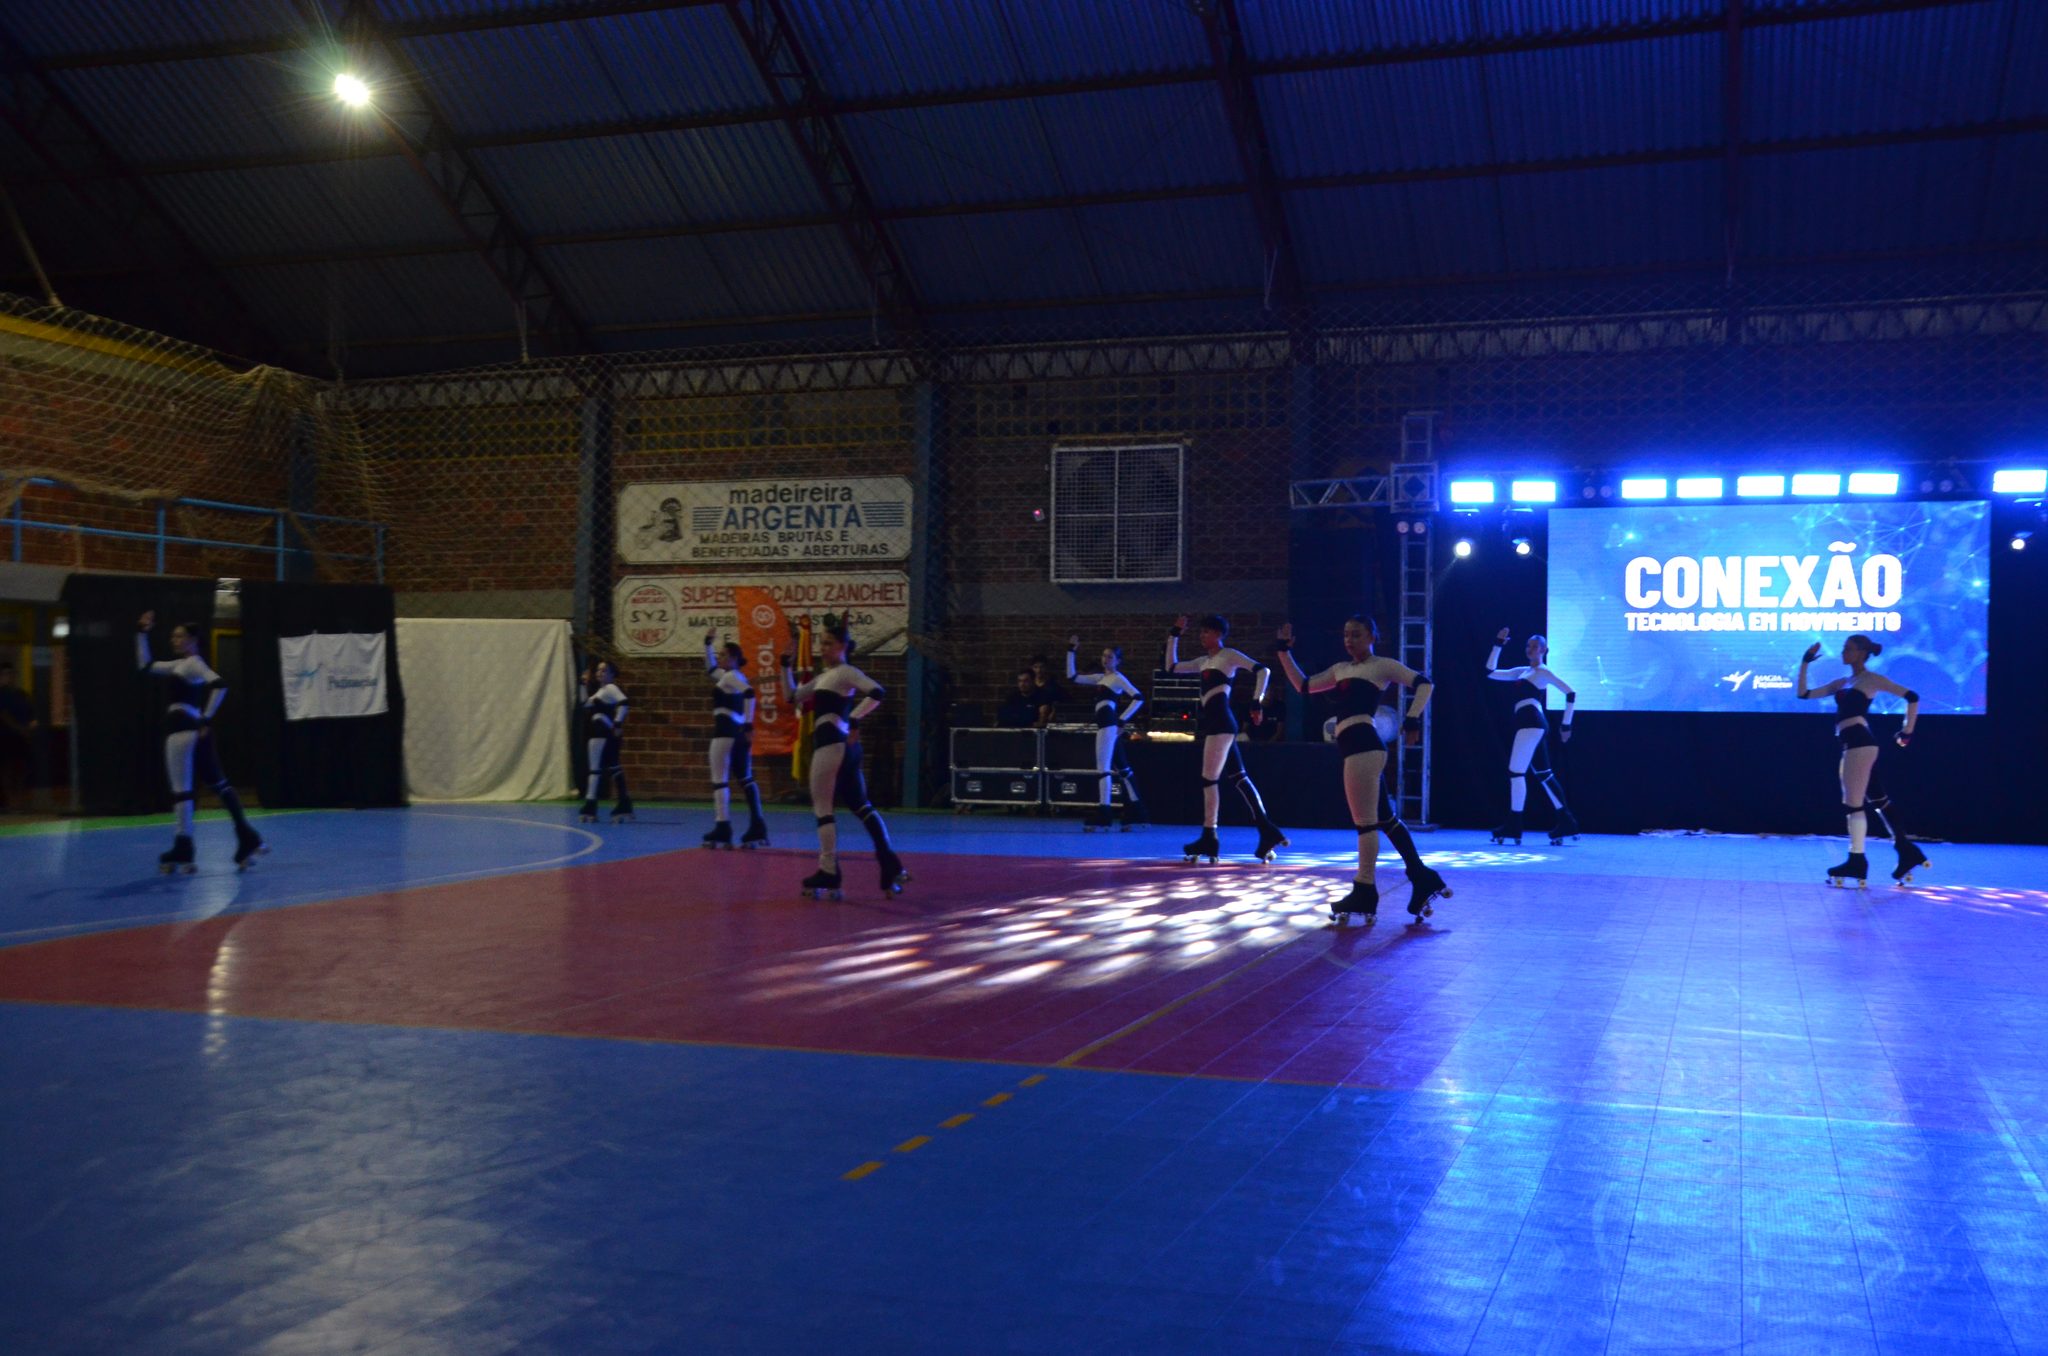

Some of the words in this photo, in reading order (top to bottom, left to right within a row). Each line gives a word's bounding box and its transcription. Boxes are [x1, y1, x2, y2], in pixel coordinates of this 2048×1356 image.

[729, 484, 853, 504] madeireira
[723, 504, 862, 531] ARGENTA
[699, 531, 771, 544] MADEIRAS
[778, 530, 833, 543] BRUTAS
[839, 530, 850, 542] E
[692, 545, 790, 558] BENEFICIADAS
[803, 543, 889, 555] ABERTURAS
[1624, 541, 1903, 609] CONEXÃO
[823, 582, 907, 602] ZANCHET
[1624, 612, 1746, 631] TECNOLOGIA
[1748, 612, 1778, 631] EM
[1781, 612, 1901, 631] MOVIMENTO
[757, 638, 779, 724] CRESOL
